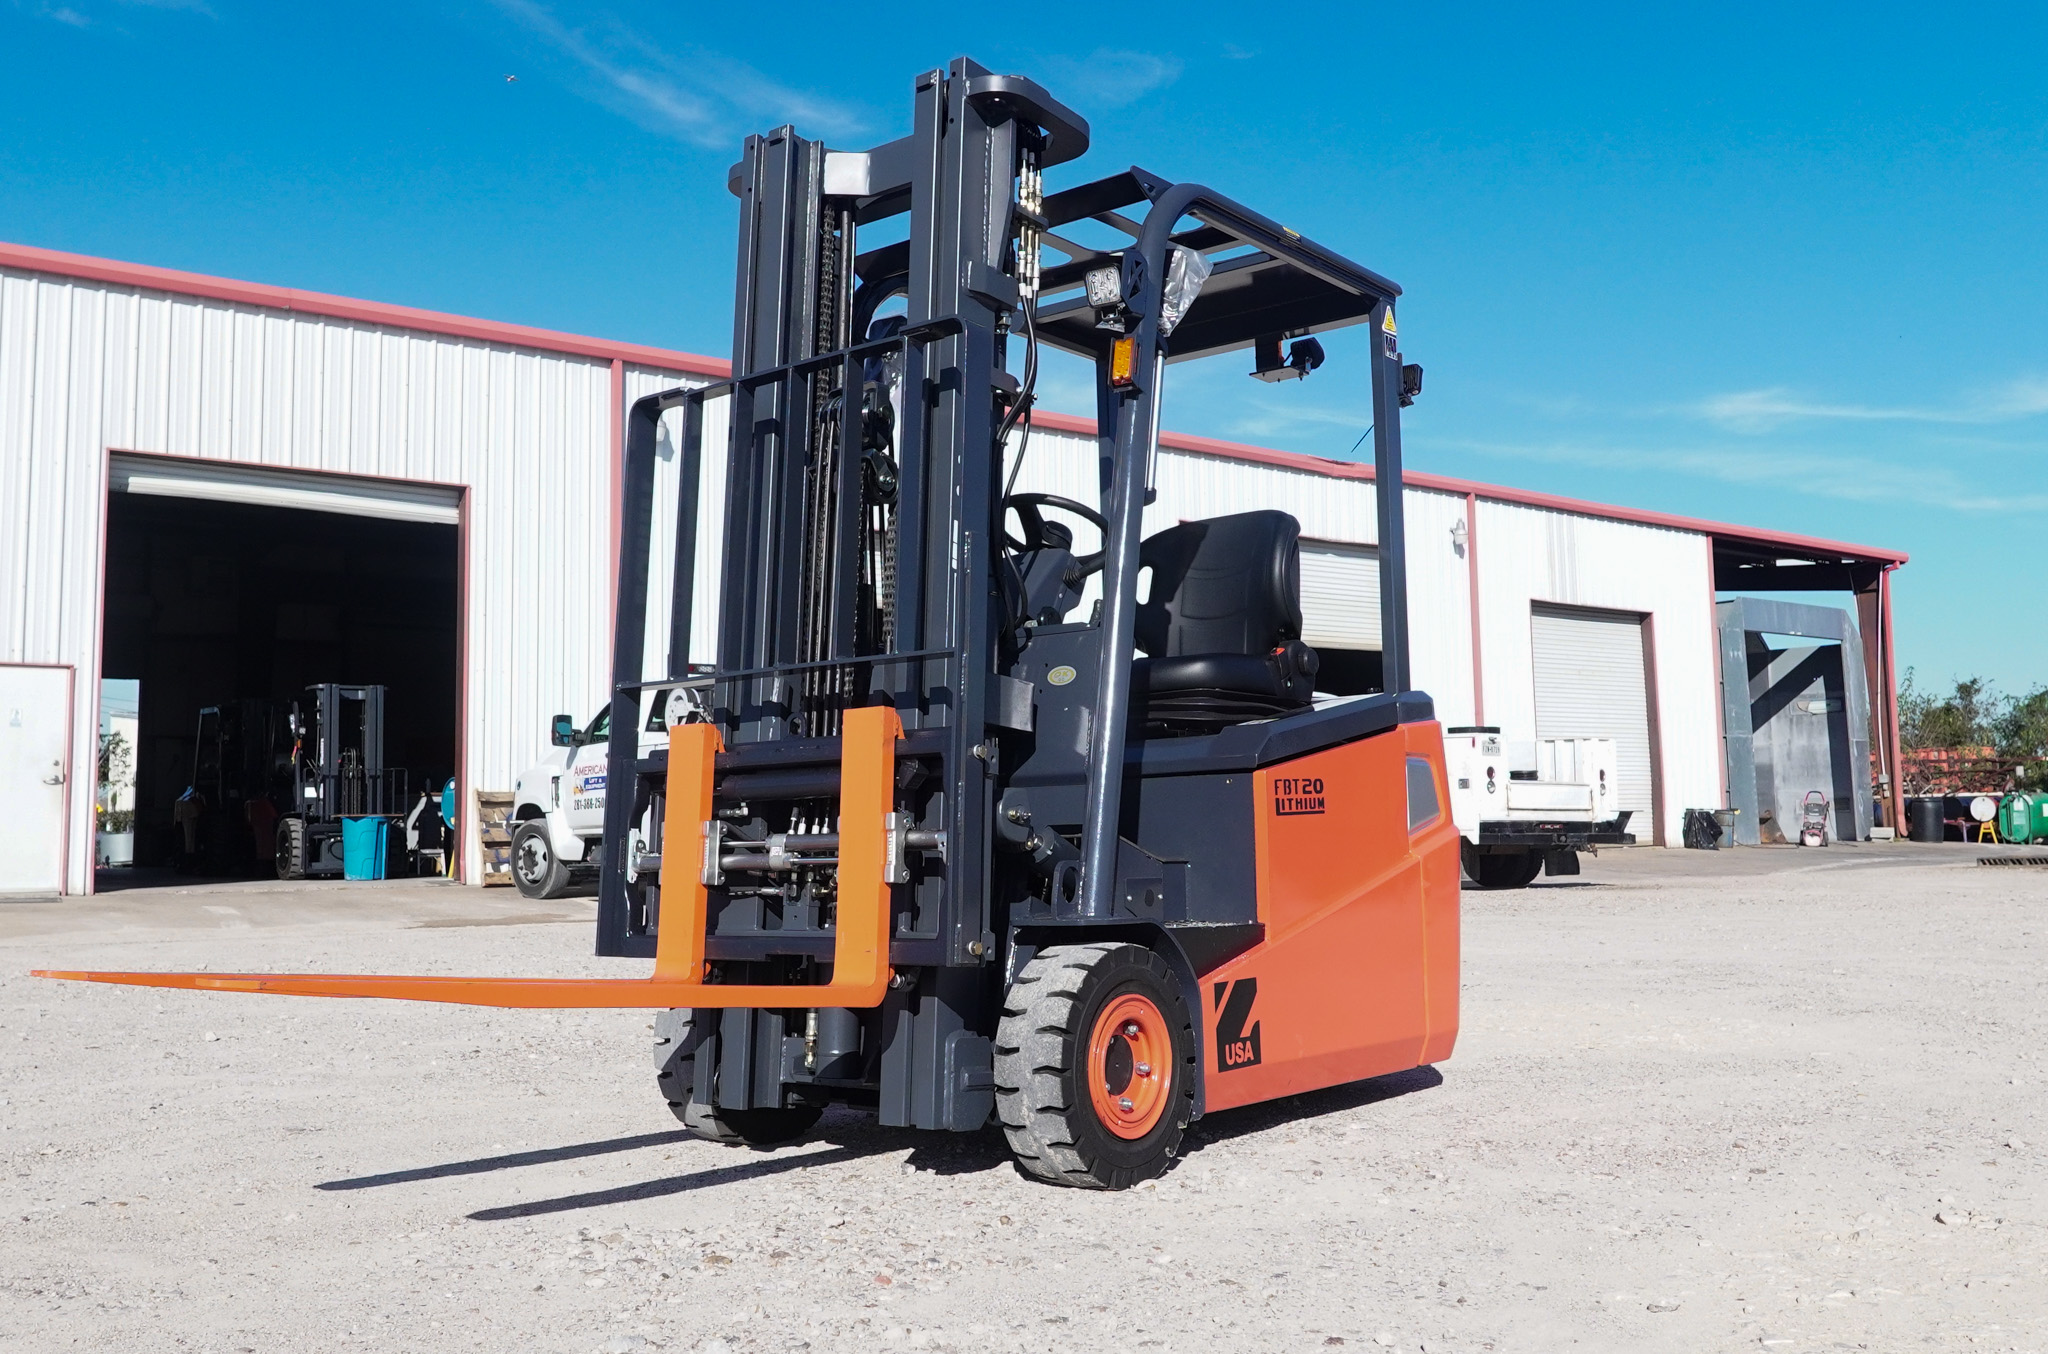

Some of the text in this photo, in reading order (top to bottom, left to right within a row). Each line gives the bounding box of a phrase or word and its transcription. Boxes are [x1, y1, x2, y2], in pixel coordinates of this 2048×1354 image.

[574, 764, 608, 776] AMERICAN
[1275, 797, 1325, 816] LITHIUM
[1225, 1040, 1254, 1066] USA
